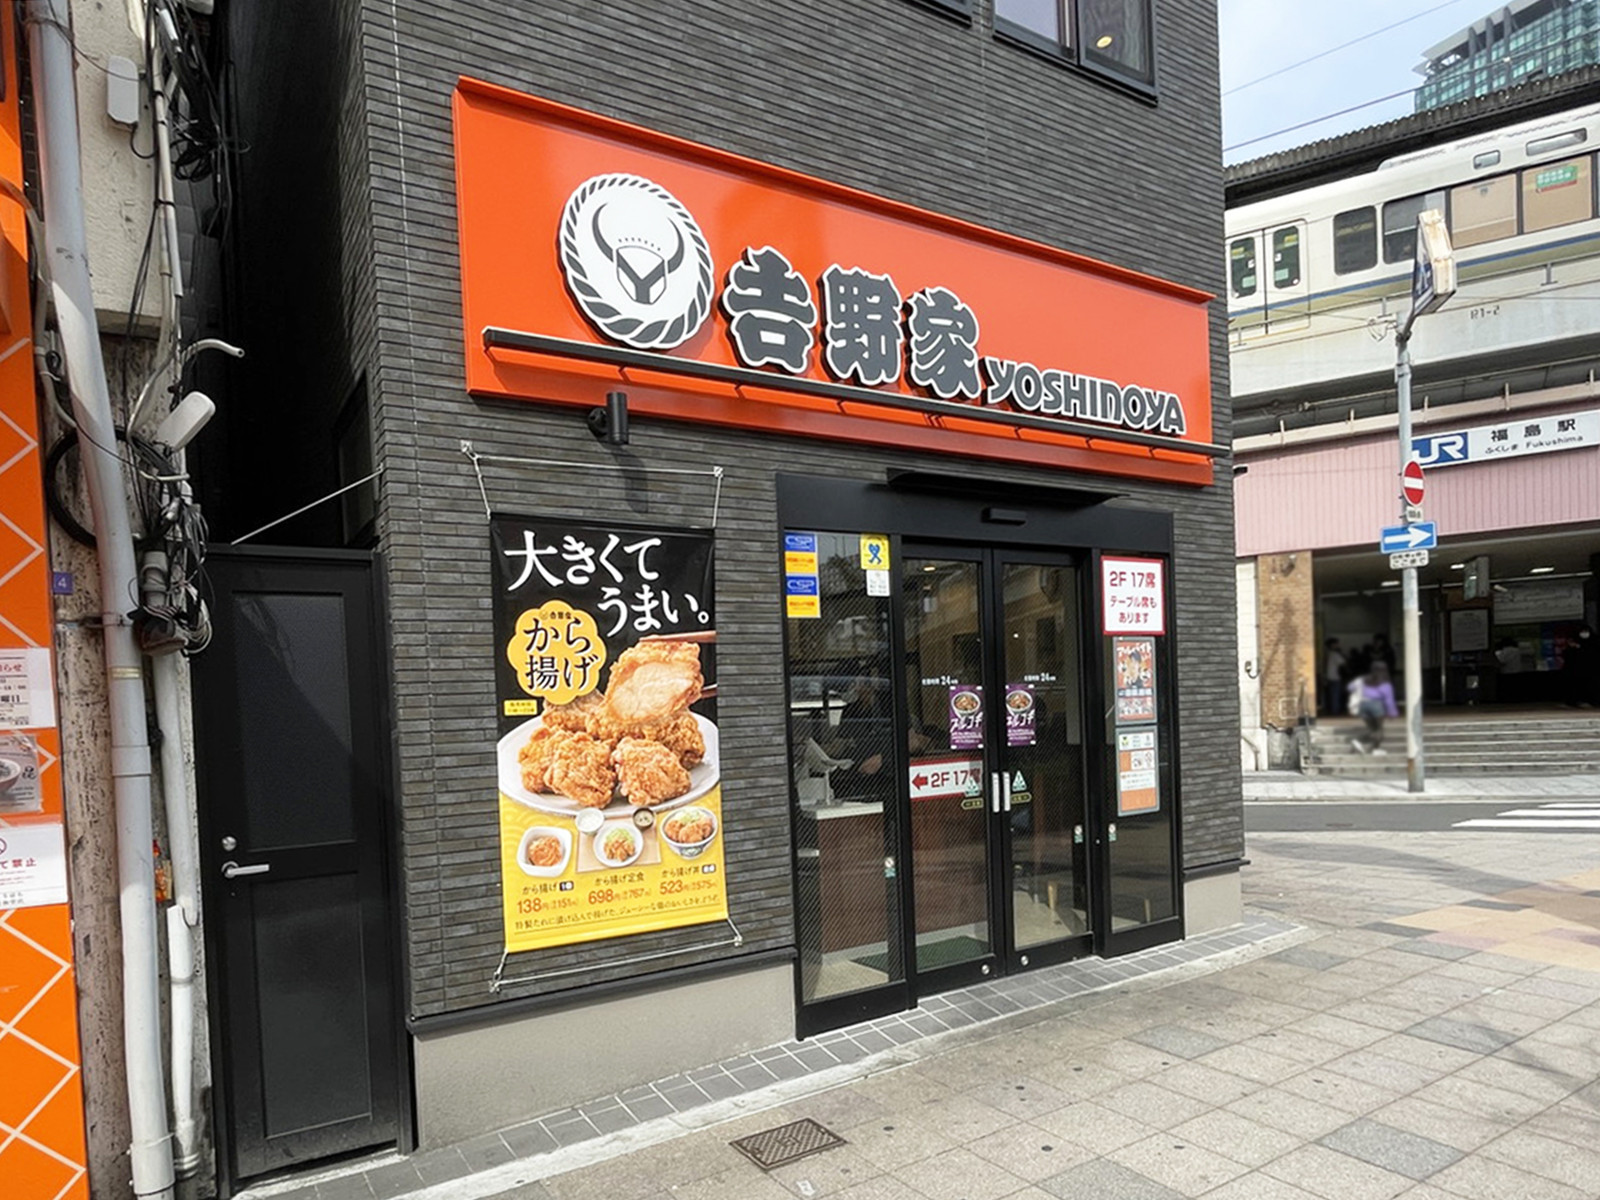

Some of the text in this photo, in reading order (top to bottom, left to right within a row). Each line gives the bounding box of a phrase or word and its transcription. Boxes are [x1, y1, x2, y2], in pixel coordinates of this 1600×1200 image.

[984, 356, 1187, 436] YOSHINOYA
[1491, 418, 1577, 442] 福島駅
[1525, 435, 1584, 449] Fukushima
[1411, 434, 1465, 464] JR
[504, 529, 663, 592] 大きくて
[1109, 570, 1127, 587] 2F
[597, 583, 710, 638] うまい。
[1110, 595, 1157, 609] テーブル席も
[1118, 611, 1149, 624] あります
[523, 617, 592, 655] から
[525, 653, 599, 690] 揚げ
[931, 771, 950, 788] 2F
